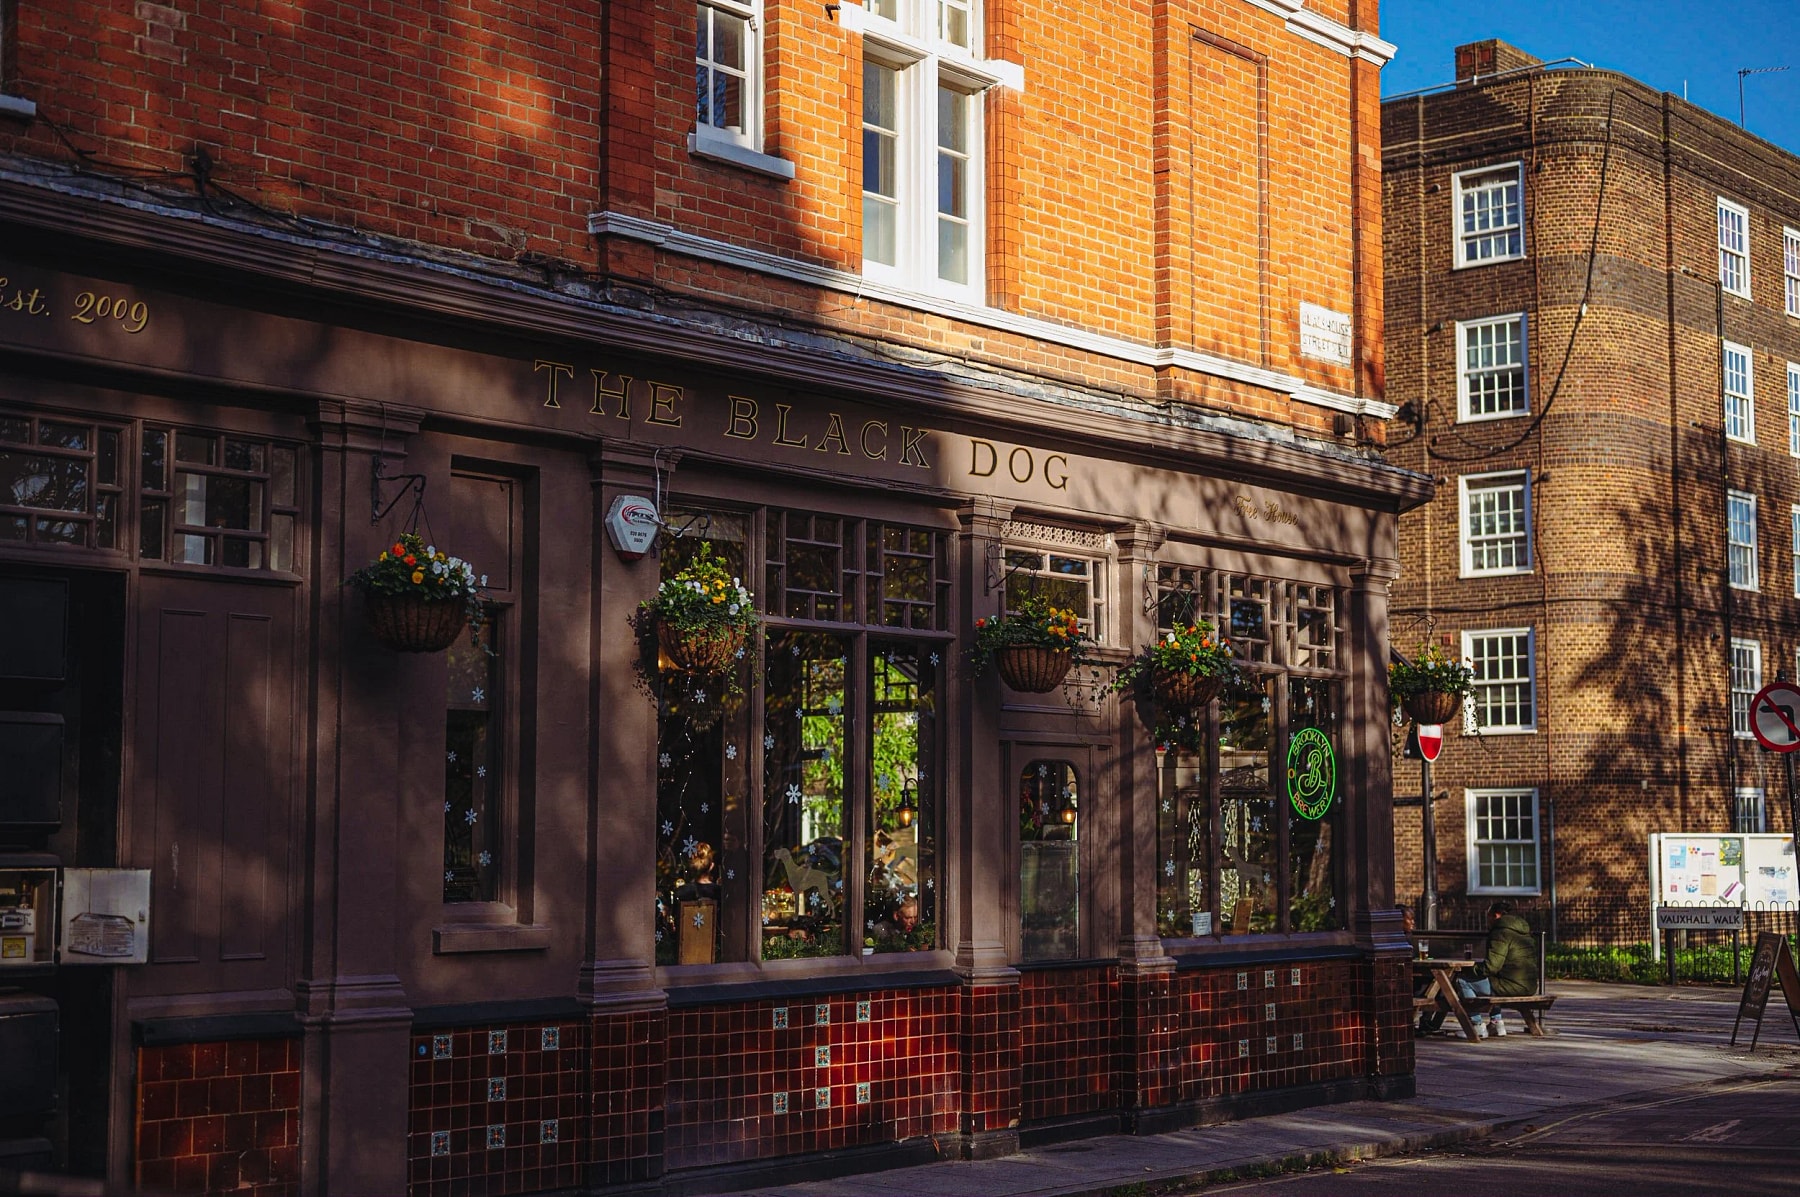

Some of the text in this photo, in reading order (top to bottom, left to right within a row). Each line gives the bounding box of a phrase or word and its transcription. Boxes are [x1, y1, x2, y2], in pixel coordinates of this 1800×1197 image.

[71, 291, 149, 334] 2009
[534, 359, 1070, 491] THE BLACK DOG
[1233, 495, 1298, 526] Free House
[1293, 730, 1330, 757] BROOKLYN
[1293, 790, 1329, 817] BREWERY
[1659, 914, 1741, 925] VAUXHALL WALK
